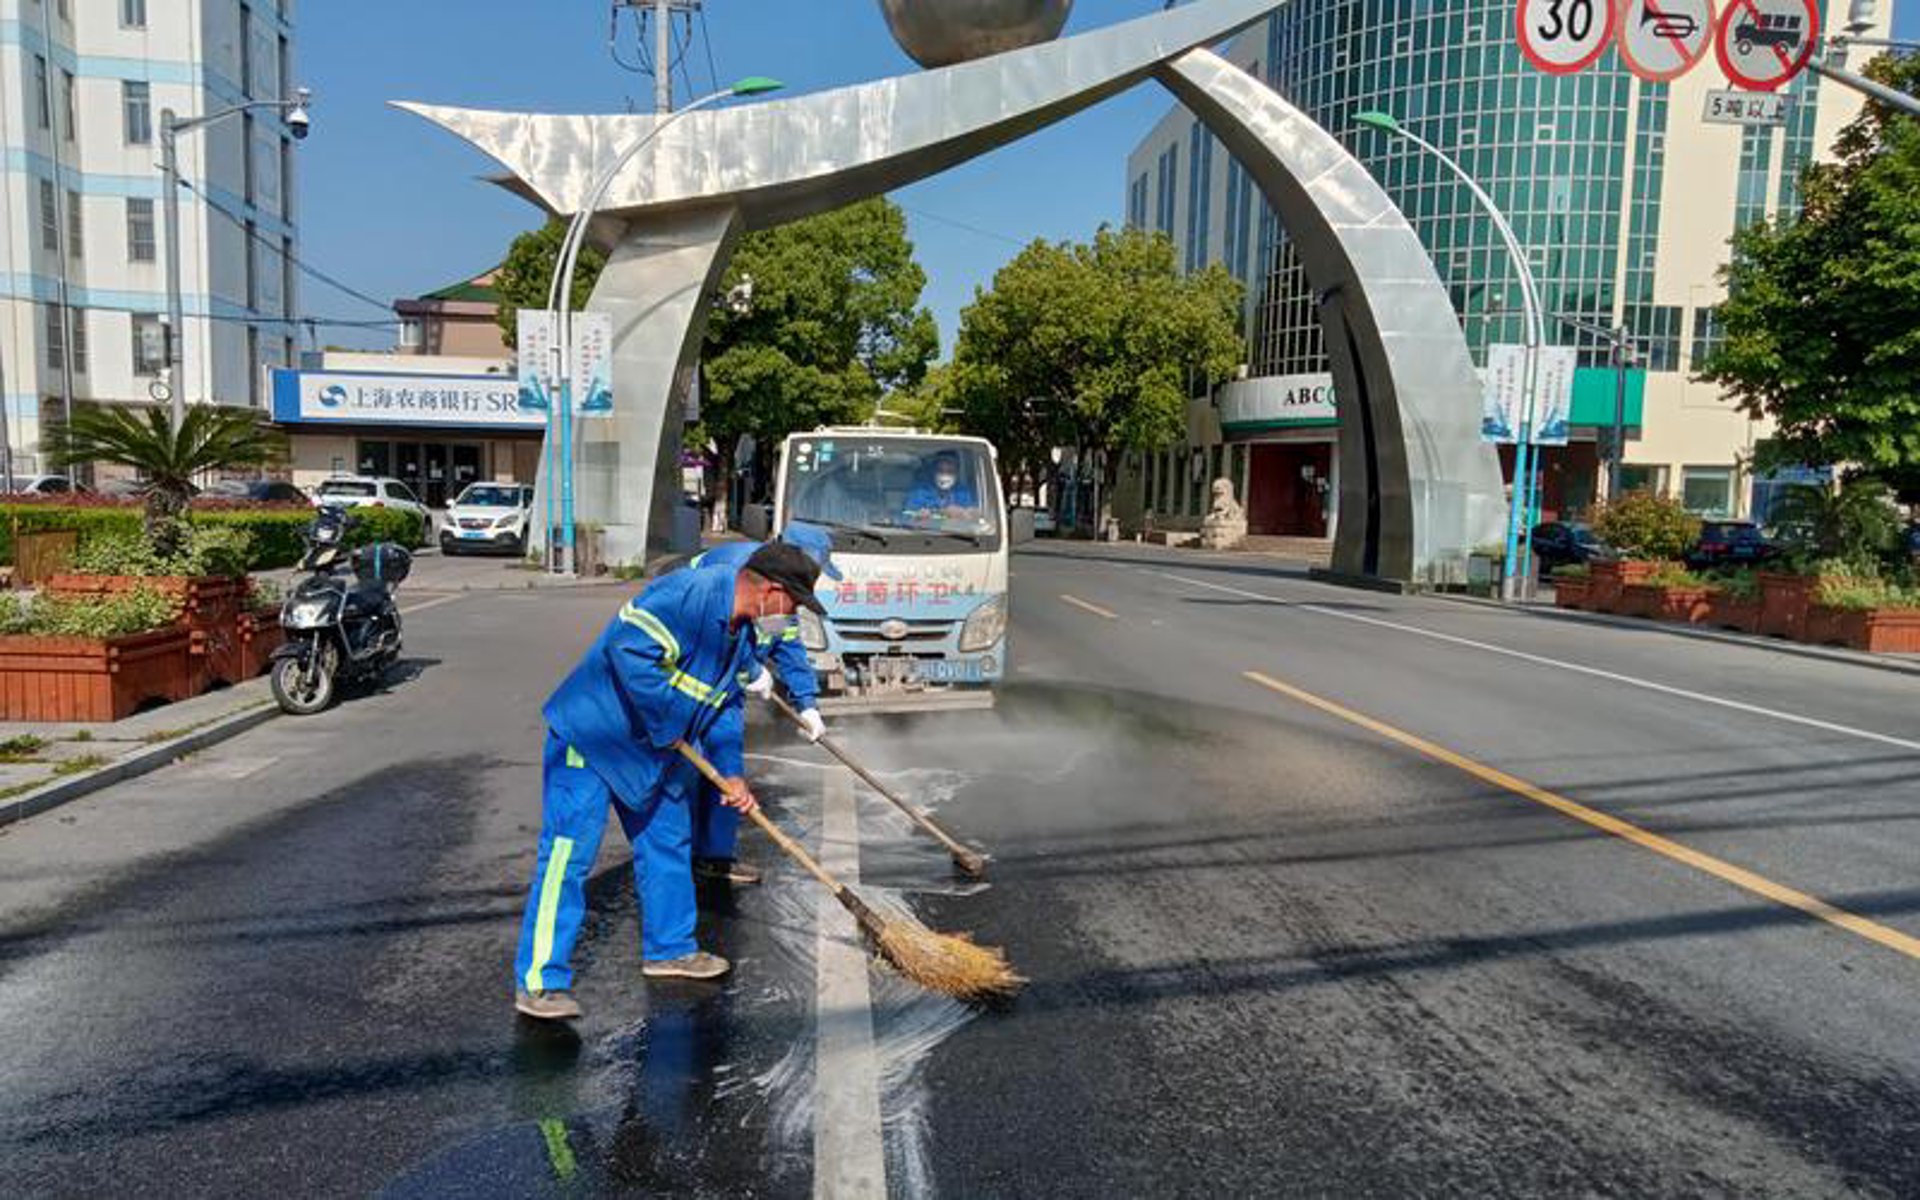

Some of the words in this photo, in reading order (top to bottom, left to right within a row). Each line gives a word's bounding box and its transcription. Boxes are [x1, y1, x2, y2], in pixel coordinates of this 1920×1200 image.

[1538, 0, 1593, 41] 30
[351, 386, 479, 412] 上海农商银行
[1283, 386, 1326, 406] ABC
